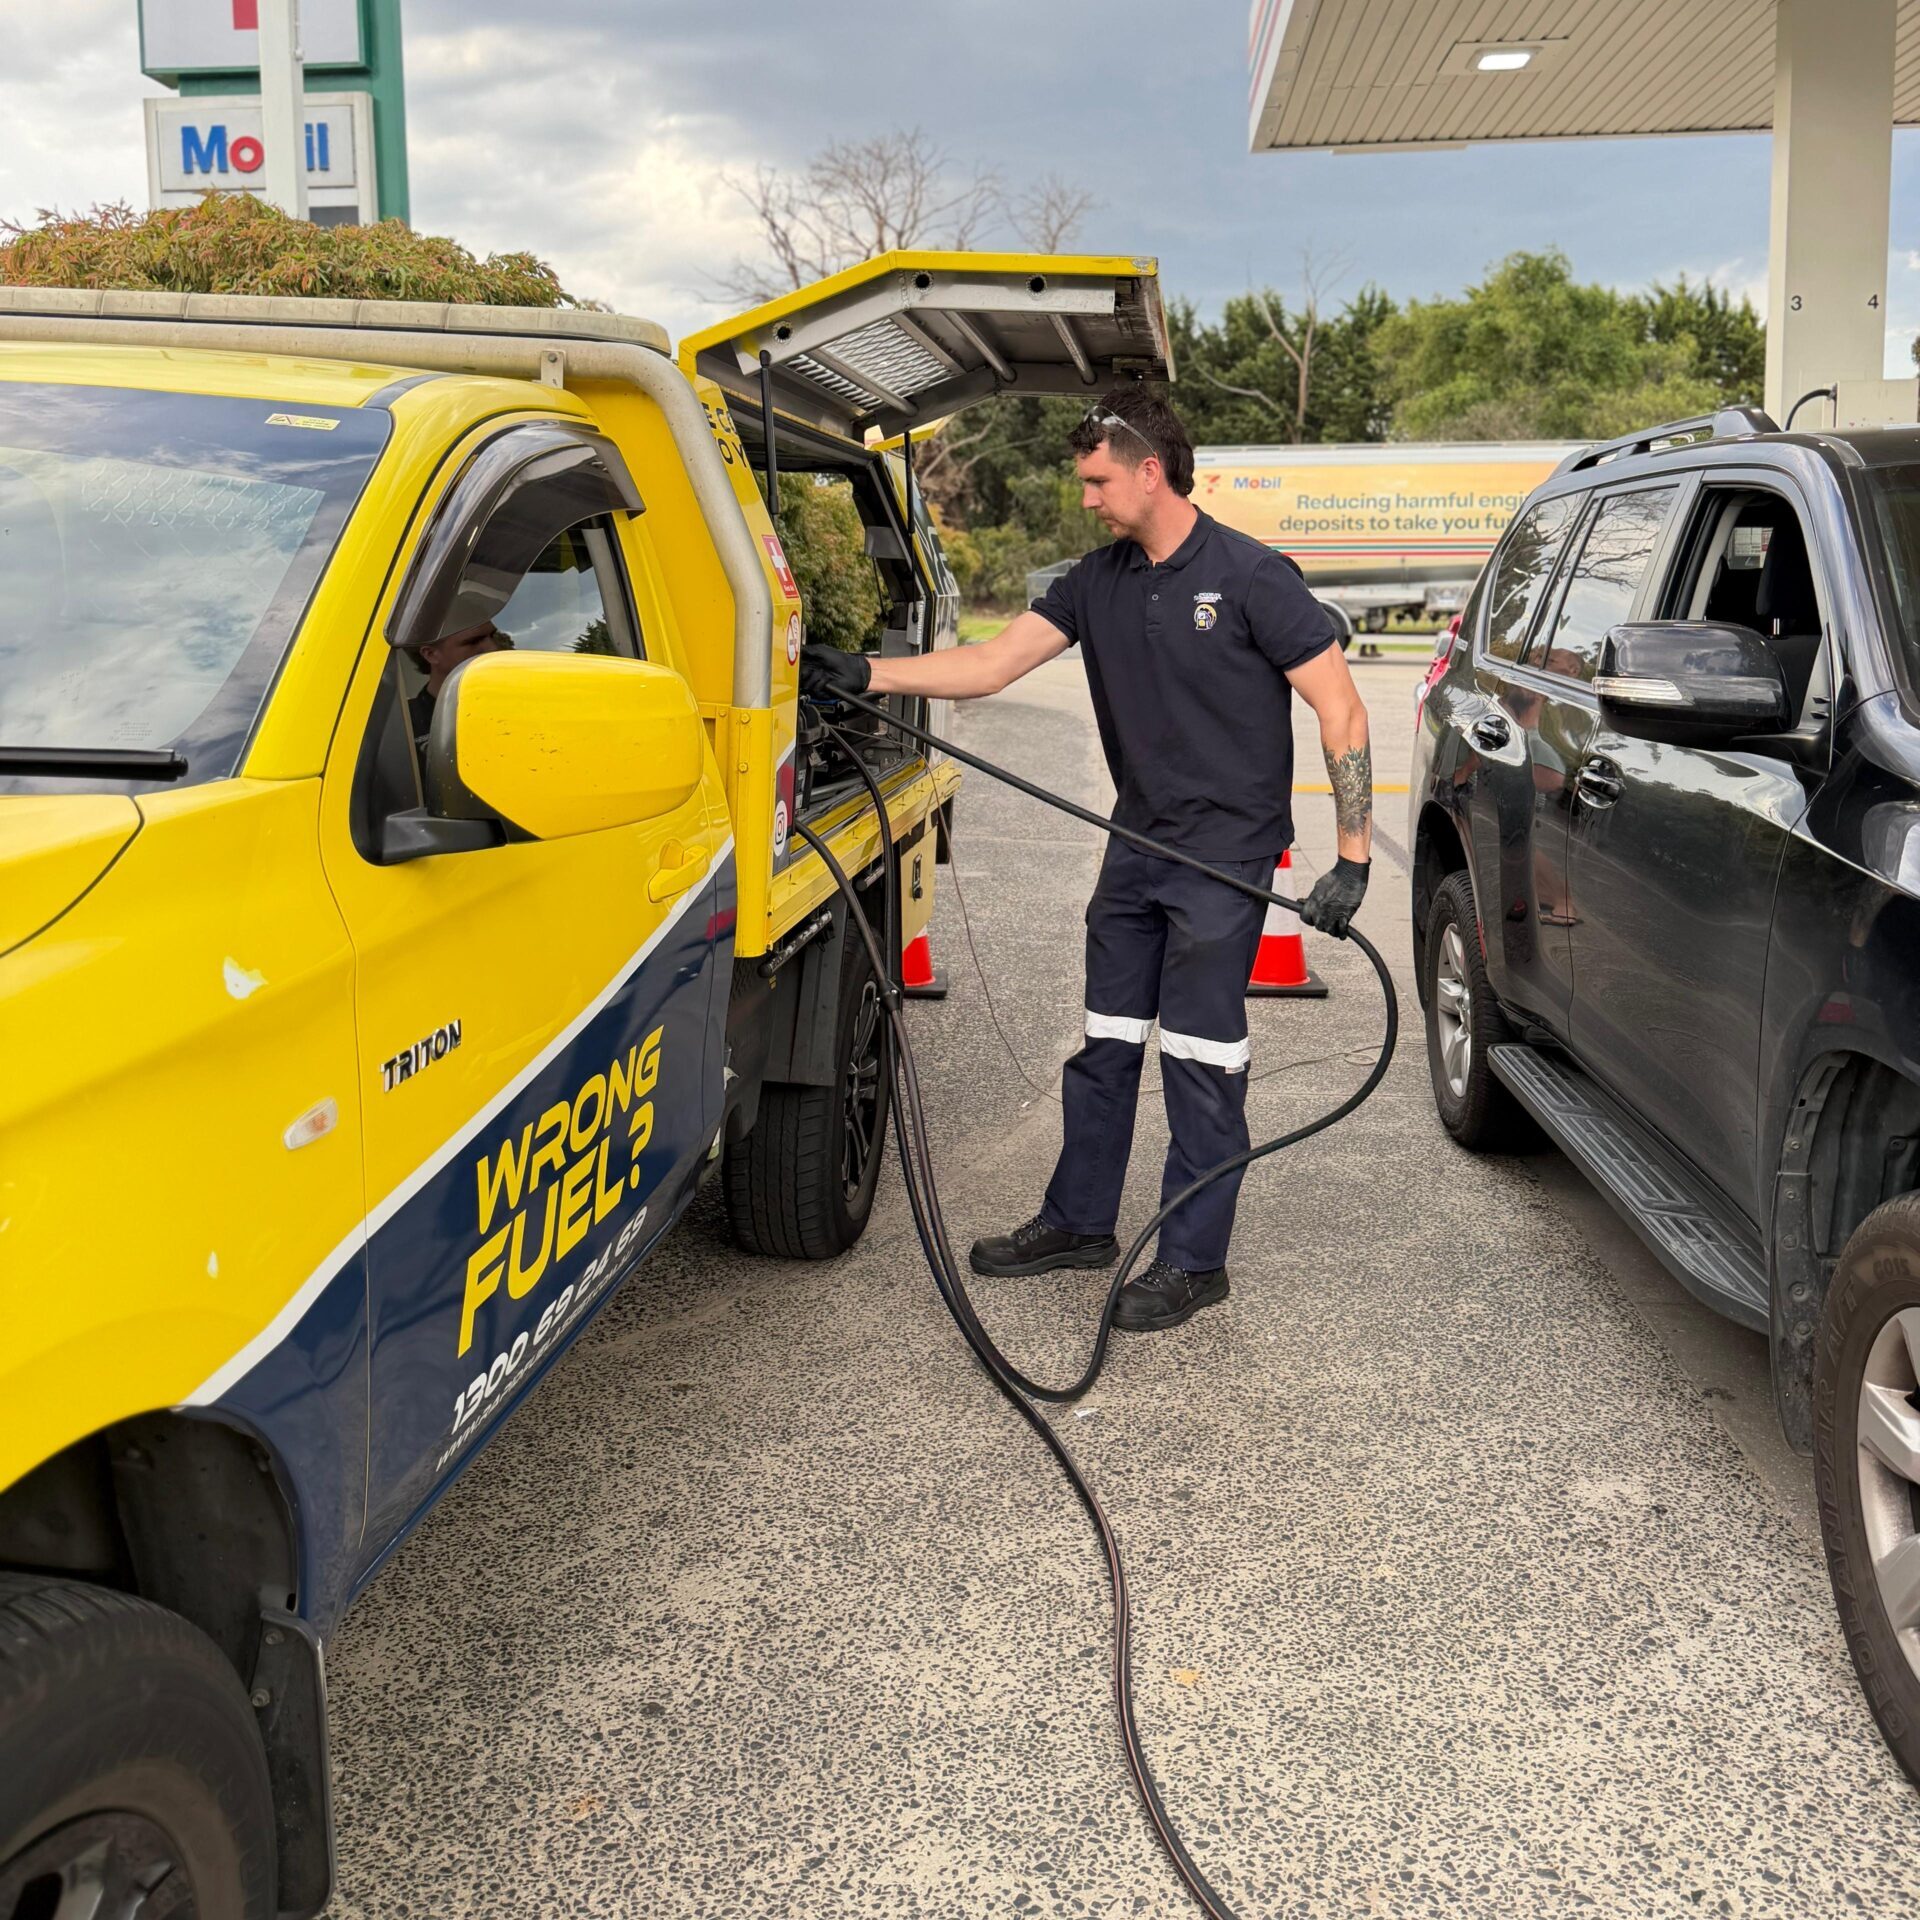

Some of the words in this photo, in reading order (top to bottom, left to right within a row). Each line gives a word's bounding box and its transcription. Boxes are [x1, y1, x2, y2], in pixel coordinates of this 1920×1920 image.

[181, 122, 329, 174] Moil
[1790, 295, 1802, 311] 3
[1867, 294, 1879, 309] 4
[1233, 477, 1282, 489] Mobil
[1296, 494, 1391, 513] Reducing
[1396, 493, 1475, 509] harmful
[1279, 516, 1364, 535] deposits
[1370, 517, 1390, 531] to
[1394, 515, 1438, 531] take
[1442, 517, 1480, 534] you
[380, 1018, 462, 1094] TRITON
[477, 1025, 664, 1236] WRONG
[457, 1100, 655, 1360] FUEL?
[451, 1331, 529, 1436] 1300
[533, 1284, 574, 1346] 69
[574, 1243, 613, 1303] 24
[614, 1206, 648, 1258] 69
